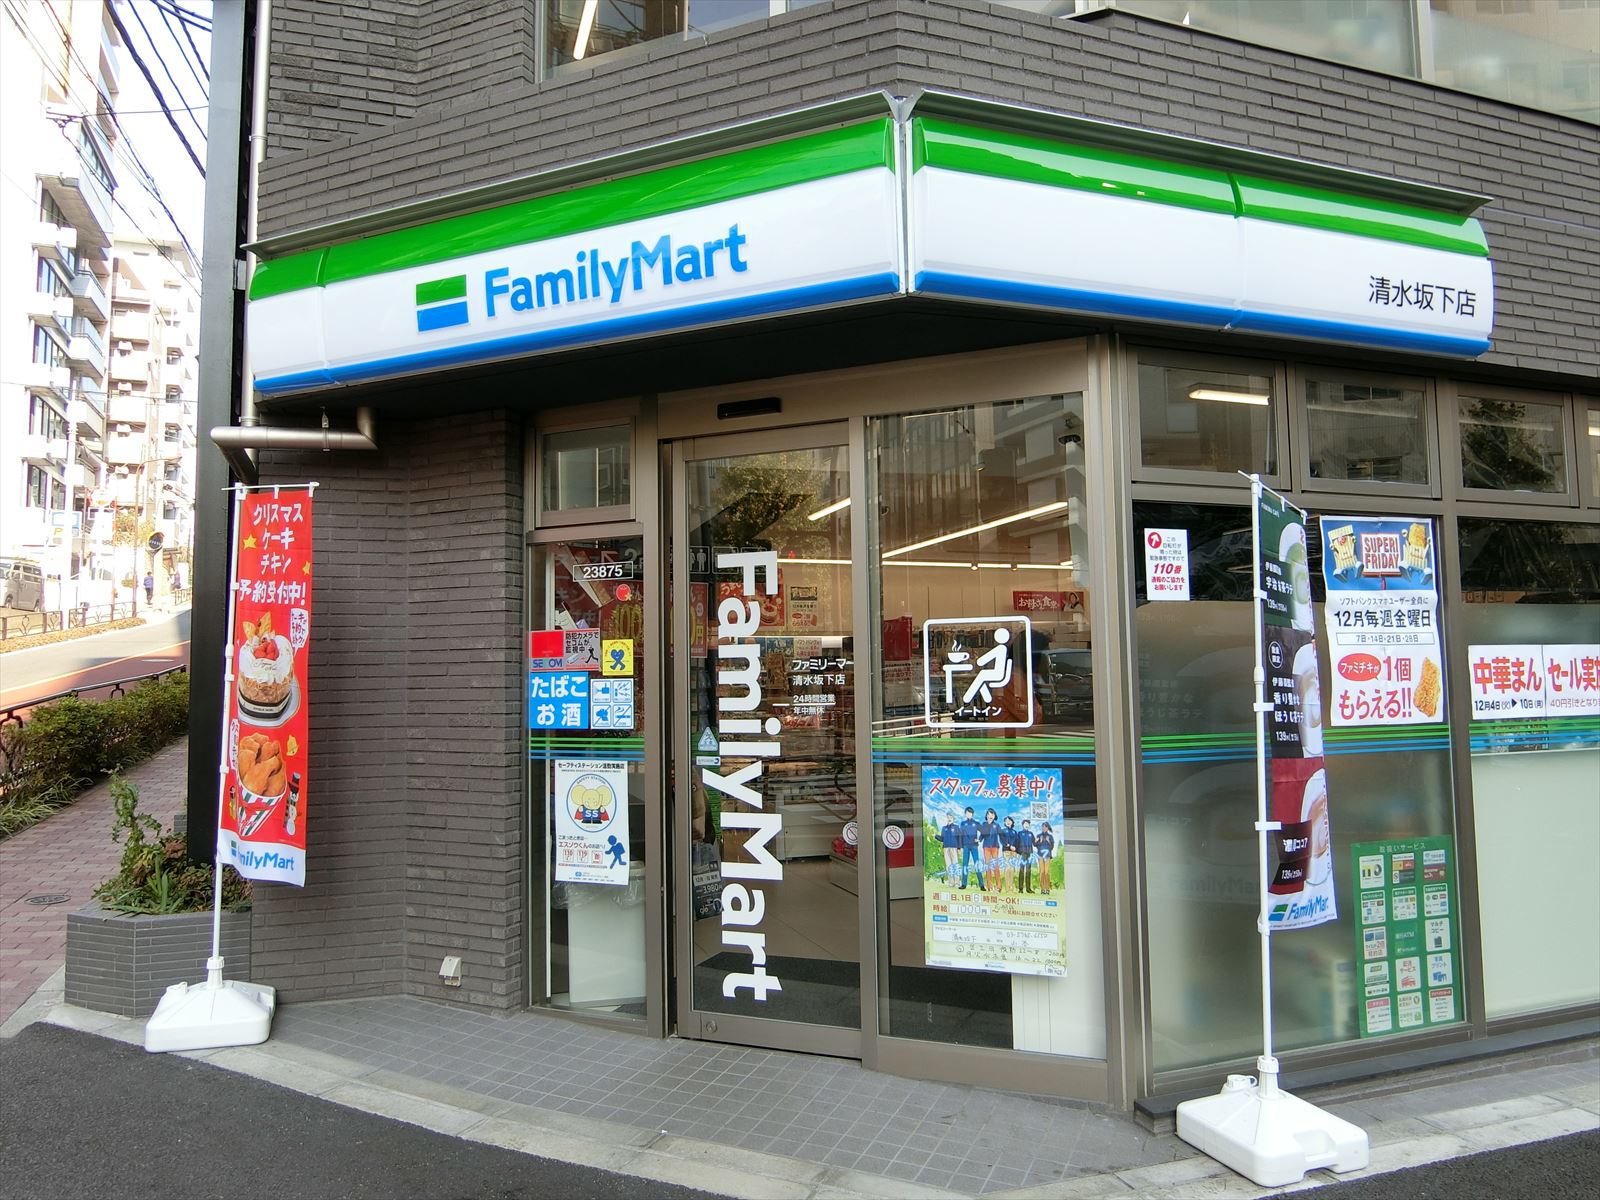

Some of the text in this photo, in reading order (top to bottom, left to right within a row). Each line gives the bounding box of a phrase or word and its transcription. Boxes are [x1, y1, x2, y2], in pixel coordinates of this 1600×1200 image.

[485, 223, 747, 317] FamilyMart
[1368, 275, 1476, 317] 清水坂下店
[253, 503, 303, 526] クリスマス
[262, 527, 295, 550] ケーキ
[260, 552, 292, 575] チキン
[583, 564, 623, 579] 23875
[1154, 563, 1182, 574] 110番
[1365, 553, 1399, 569] FRIDAY
[239, 579, 307, 606] 予約受付中!
[1334, 609, 1431, 628] 12月毎週金曜日
[565, 631, 599, 640] 防犯カメラで
[533, 658, 563, 668] SEOM
[1383, 656, 1411, 682] 1個
[531, 675, 587, 698] たばこ
[792, 674, 846, 686] 清水坂下店
[1473, 657, 1542, 694] 中華まん
[793, 694, 836, 704] 24時間営業
[793, 705, 825, 715] 年中無休
[537, 703, 581, 727] お酒
[955, 706, 1002, 716] イートイン
[702, 550, 784, 1002] FamilyMart
[929, 774, 1055, 799] スタッフさん募集中!
[585, 809, 599, 818] SS
